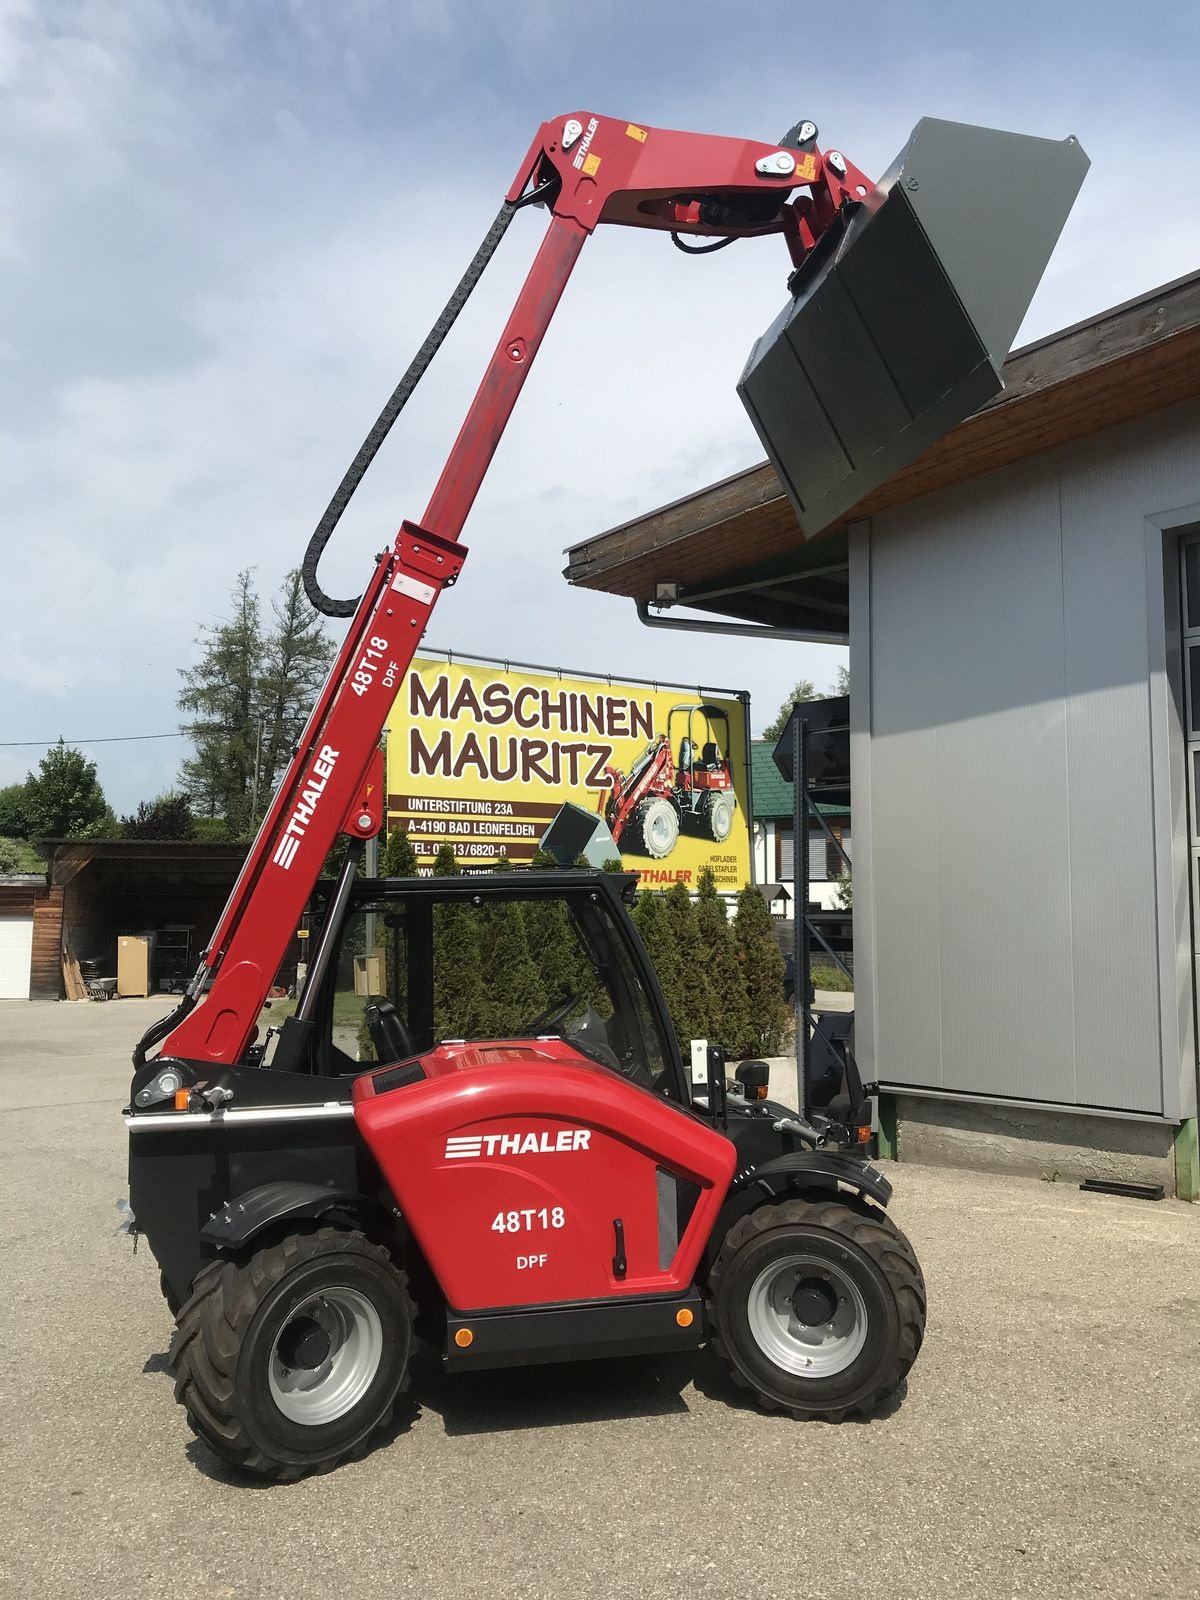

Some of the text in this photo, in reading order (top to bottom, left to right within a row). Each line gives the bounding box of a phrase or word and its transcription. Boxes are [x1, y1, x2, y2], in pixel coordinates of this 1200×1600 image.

[350, 635, 389, 697] 48T18
[381, 660, 401, 688] DPF
[409, 672, 654, 740] MASCHINEN
[409, 727, 615, 788] MAURITZ
[407, 798, 513, 816] UNTERSTIFTUNG 23A
[407, 819, 535, 837] A-4190 BAD LEONFELDEN
[432, 843, 506, 857] 013/6820-0
[709, 855, 738, 863] HOFLADER
[696, 874, 738, 884] BSCHINEN
[491, 1206, 565, 1234] 48T18
[516, 1253, 548, 1270] DPF
